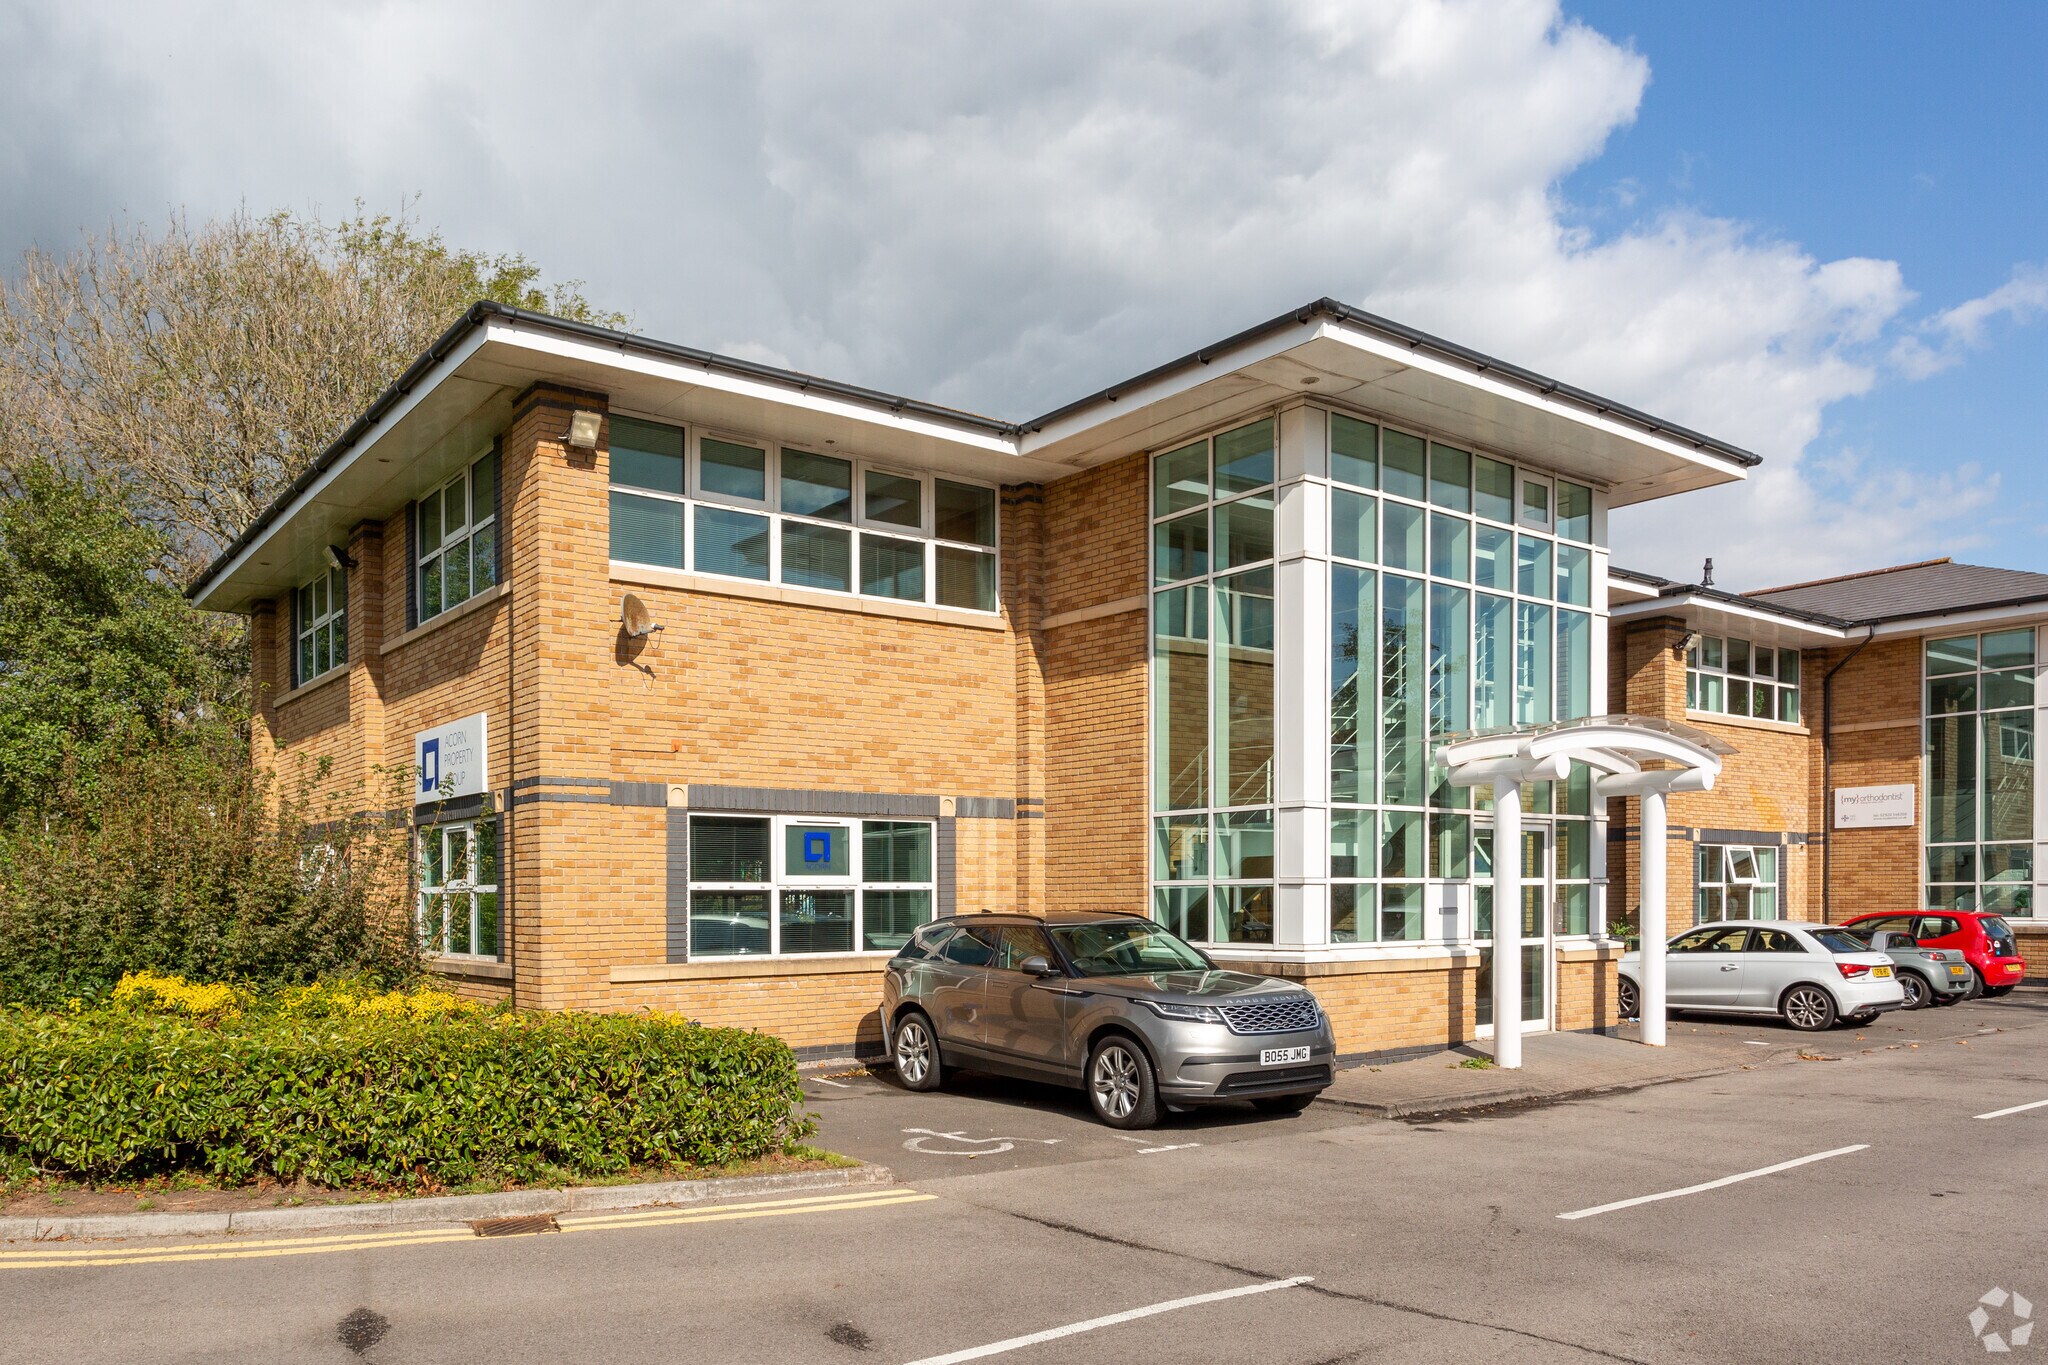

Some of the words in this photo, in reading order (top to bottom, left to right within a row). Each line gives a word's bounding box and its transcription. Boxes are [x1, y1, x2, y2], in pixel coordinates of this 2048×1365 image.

[444, 730, 467, 748] ACORN
[444, 747, 474, 766] PROPERTY
[446, 771, 466, 786] OUP
[1291, 1048, 1307, 1060] JMG
